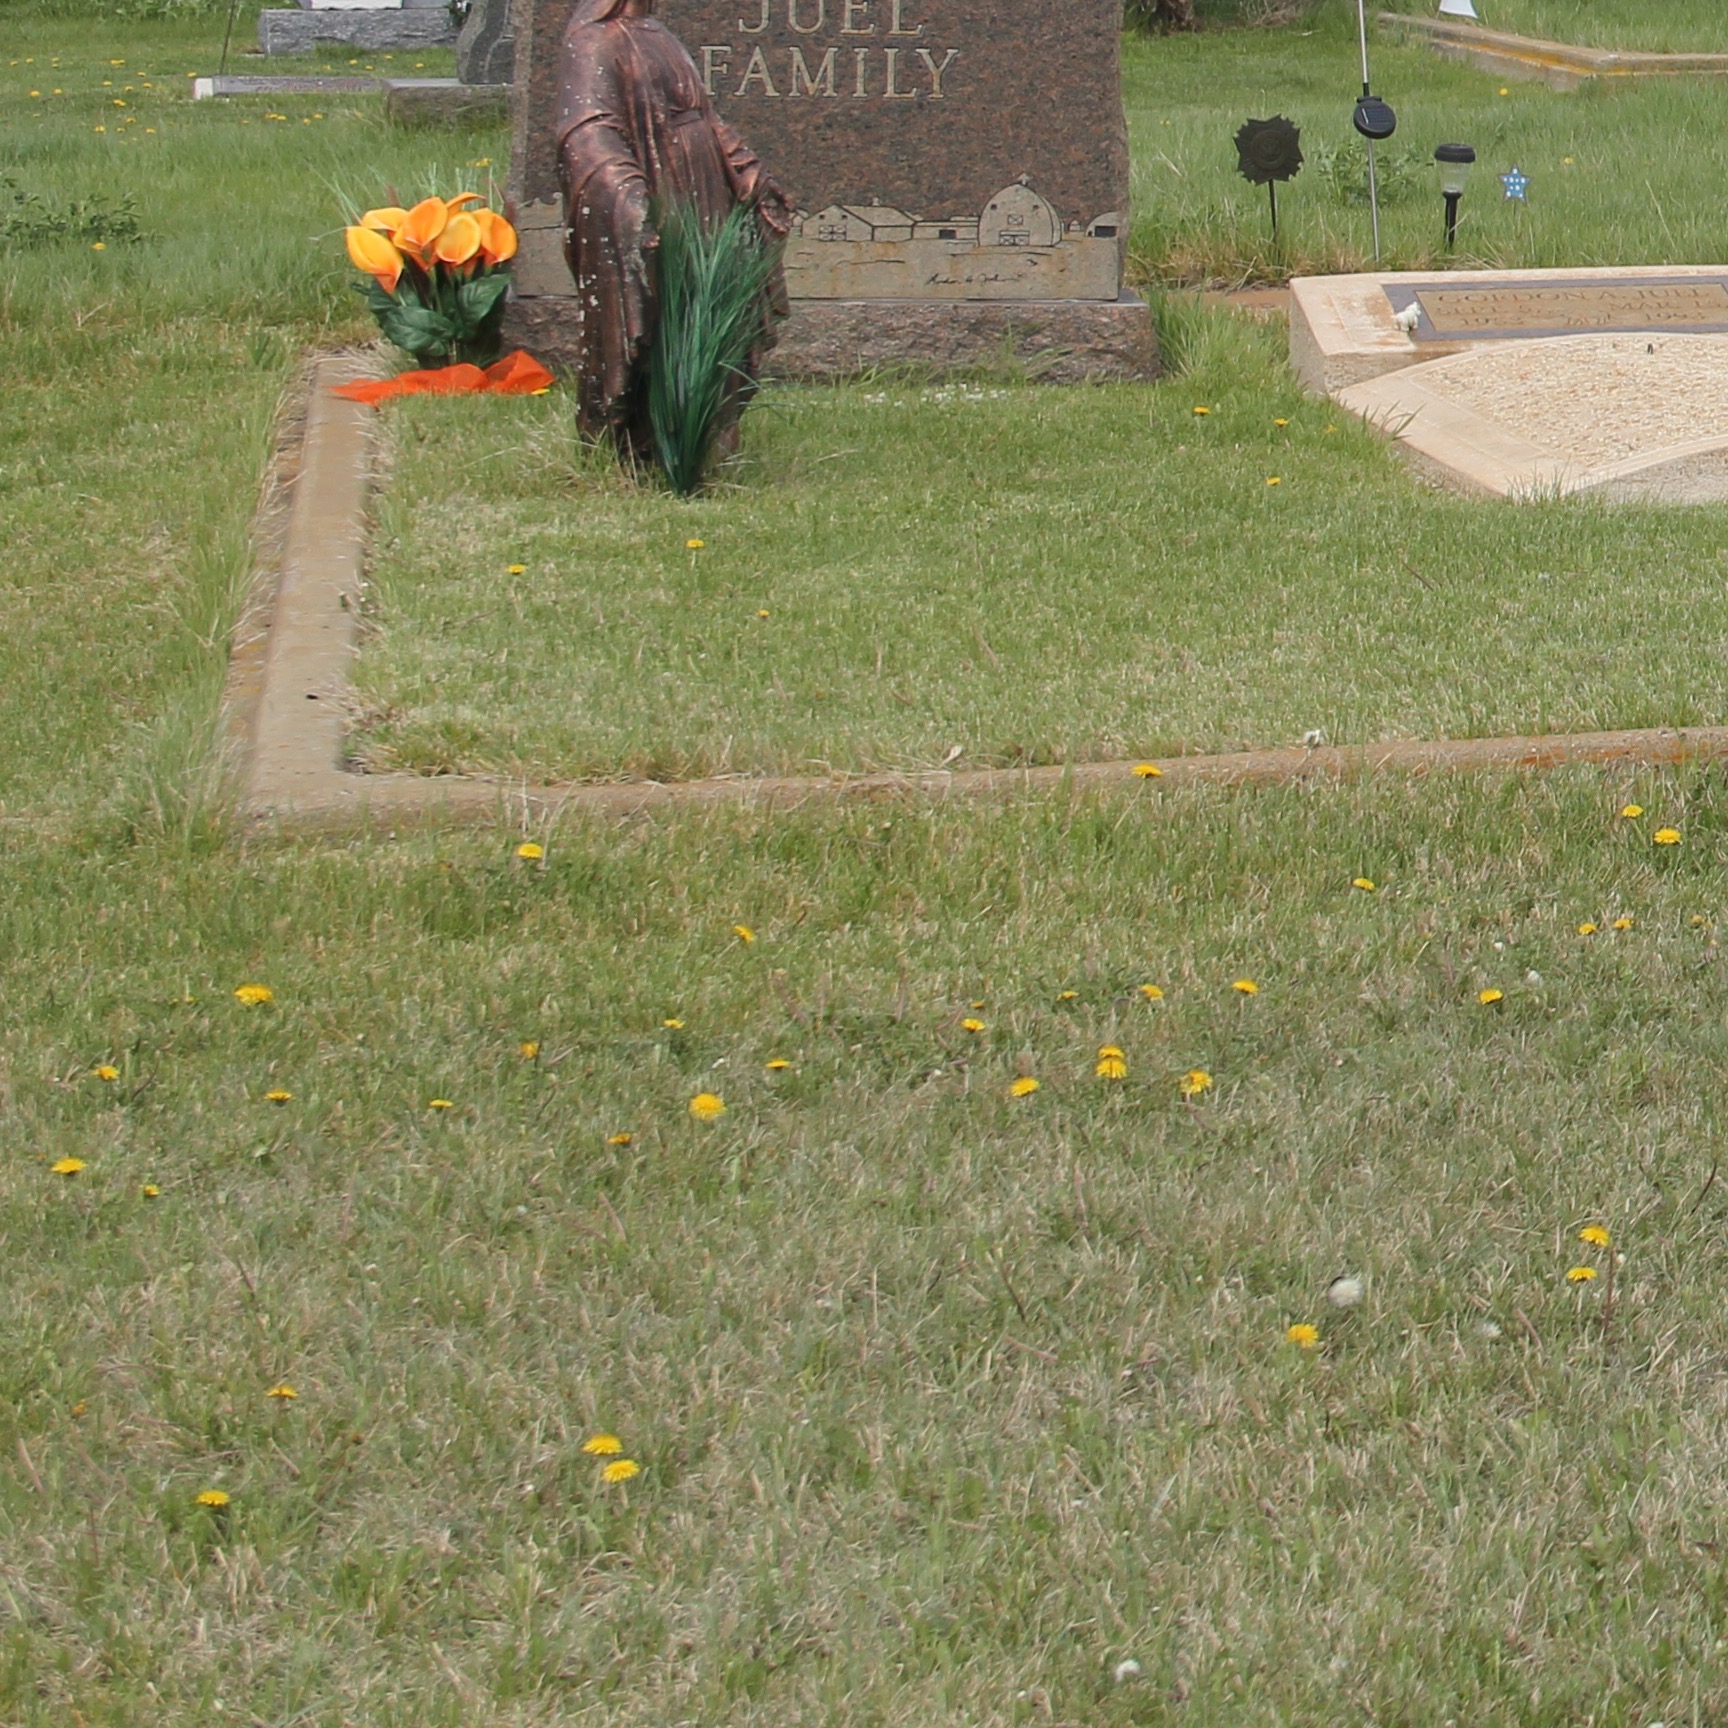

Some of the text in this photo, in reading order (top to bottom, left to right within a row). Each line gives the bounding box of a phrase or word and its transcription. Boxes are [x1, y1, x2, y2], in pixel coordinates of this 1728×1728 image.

[700, 45, 960, 99] FAMILY
[1438, 291, 1586, 304] GORDON
[1638, 288, 1710, 300] JUEL
